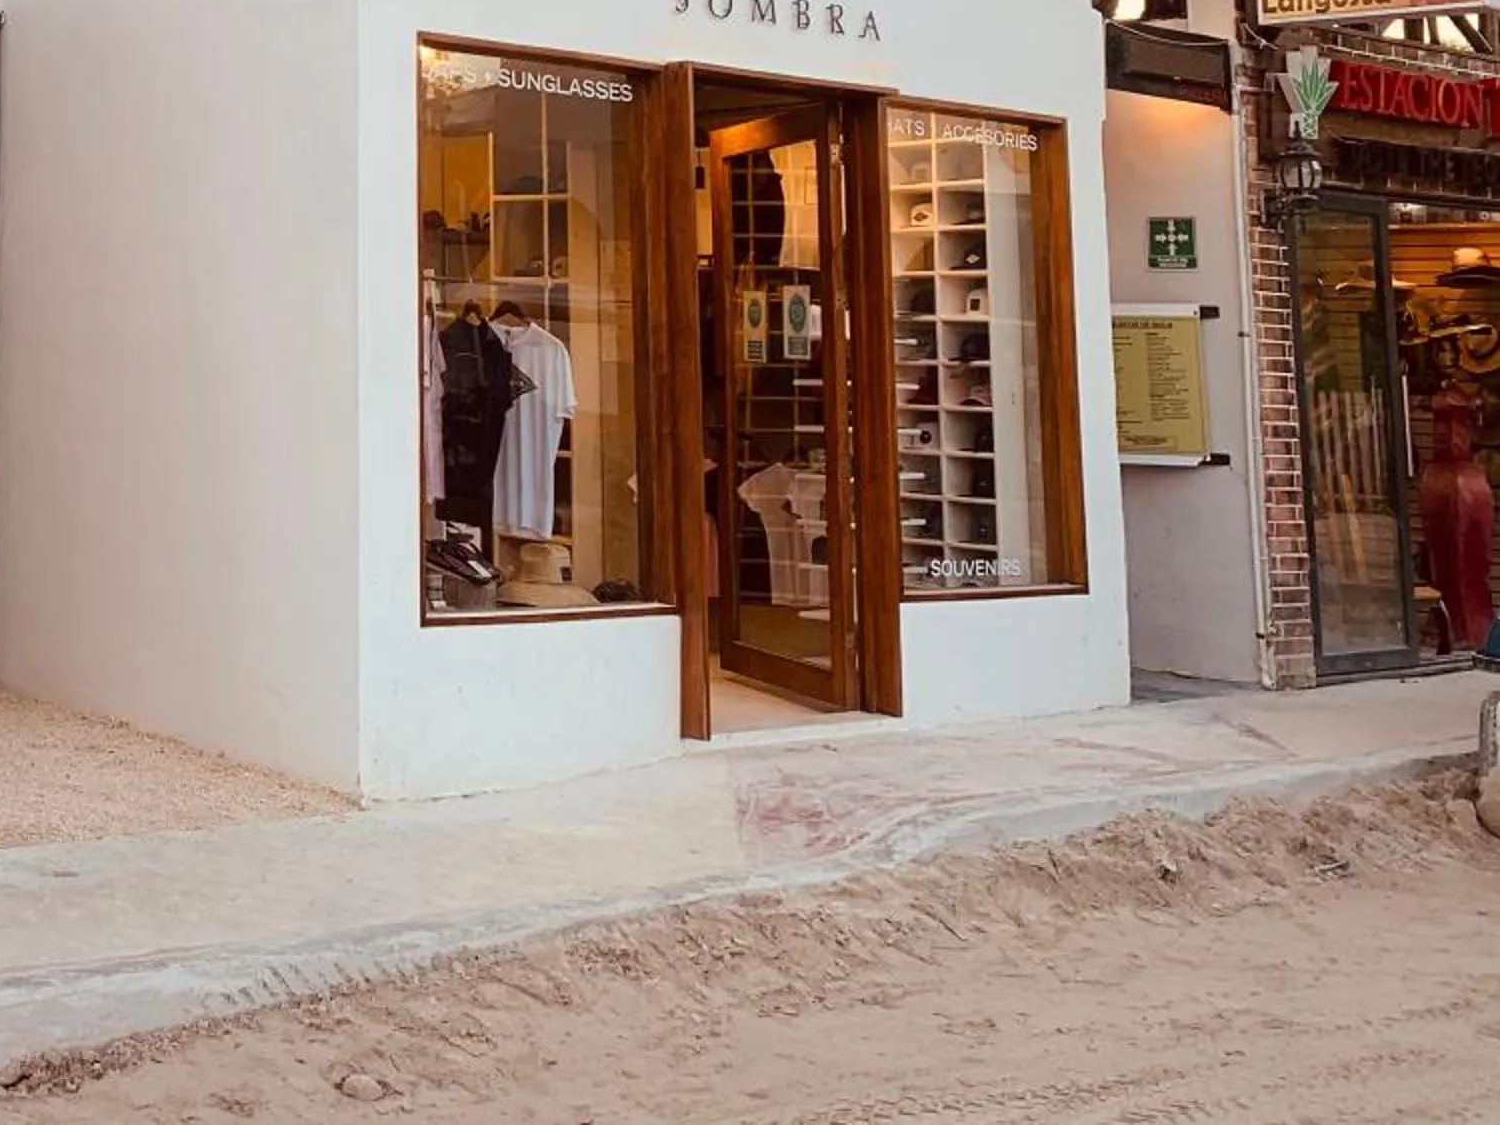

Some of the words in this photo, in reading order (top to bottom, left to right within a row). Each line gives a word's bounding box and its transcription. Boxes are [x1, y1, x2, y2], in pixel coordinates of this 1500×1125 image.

[499, 68, 633, 102] SUNGLASSES
[943, 124, 1038, 152] ACCESORIES
[930, 558, 1021, 576] SOUVENIRS
